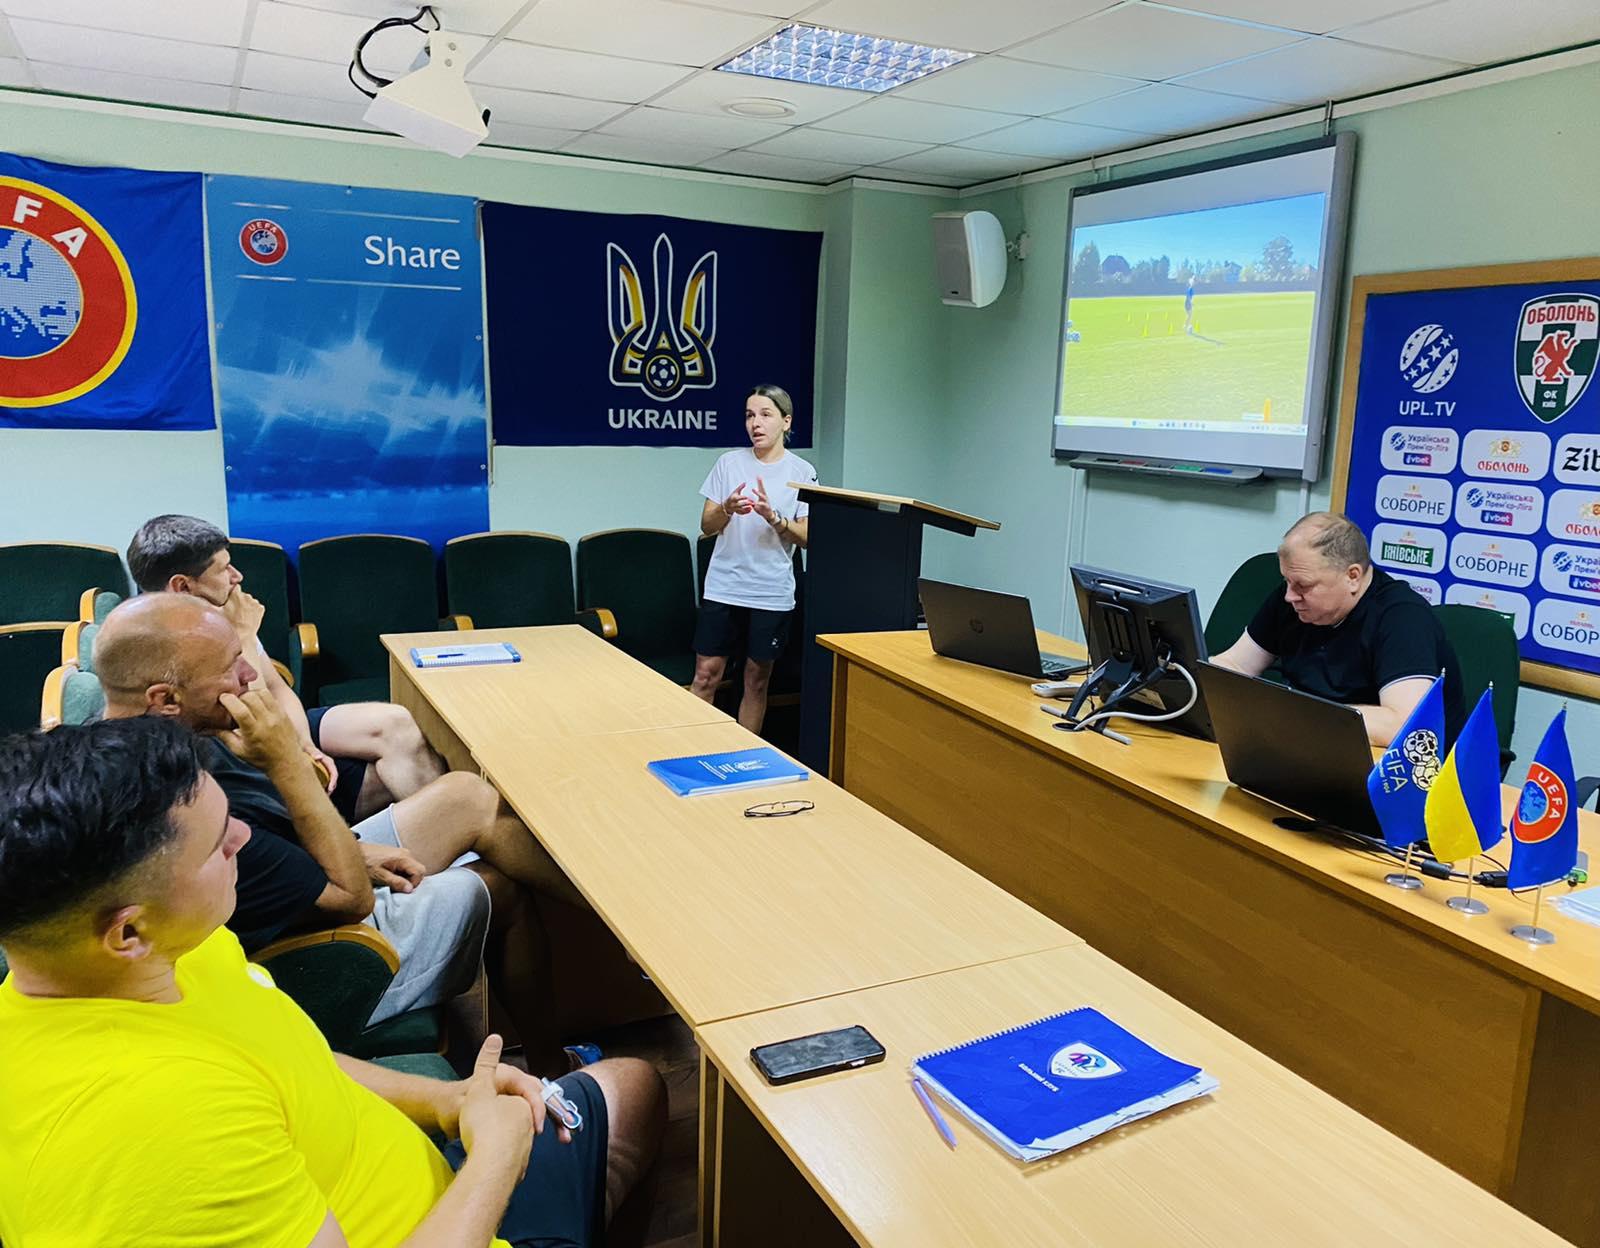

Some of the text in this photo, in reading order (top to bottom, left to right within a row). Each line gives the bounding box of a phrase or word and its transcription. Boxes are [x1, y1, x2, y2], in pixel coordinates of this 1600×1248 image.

[248, 221, 277, 233] UEFA
[364, 235, 460, 270] Share
[1527, 305, 1596, 325] ОБОЛОНЬ
[1543, 390, 1558, 399] ФК
[1399, 400, 1457, 416] UPL.TV
[608, 409, 717, 430] UKRAINE
[1478, 460, 1529, 474] ОБОЛОНЬ
[1381, 497, 1446, 516] СОБОРНЕ
[1565, 523, 1600, 536] ОБОЛ
[1455, 555, 1529, 578] СОБОРНЕ
[1385, 748, 1409, 792] FIFA
[1538, 771, 1563, 819] UEFA
